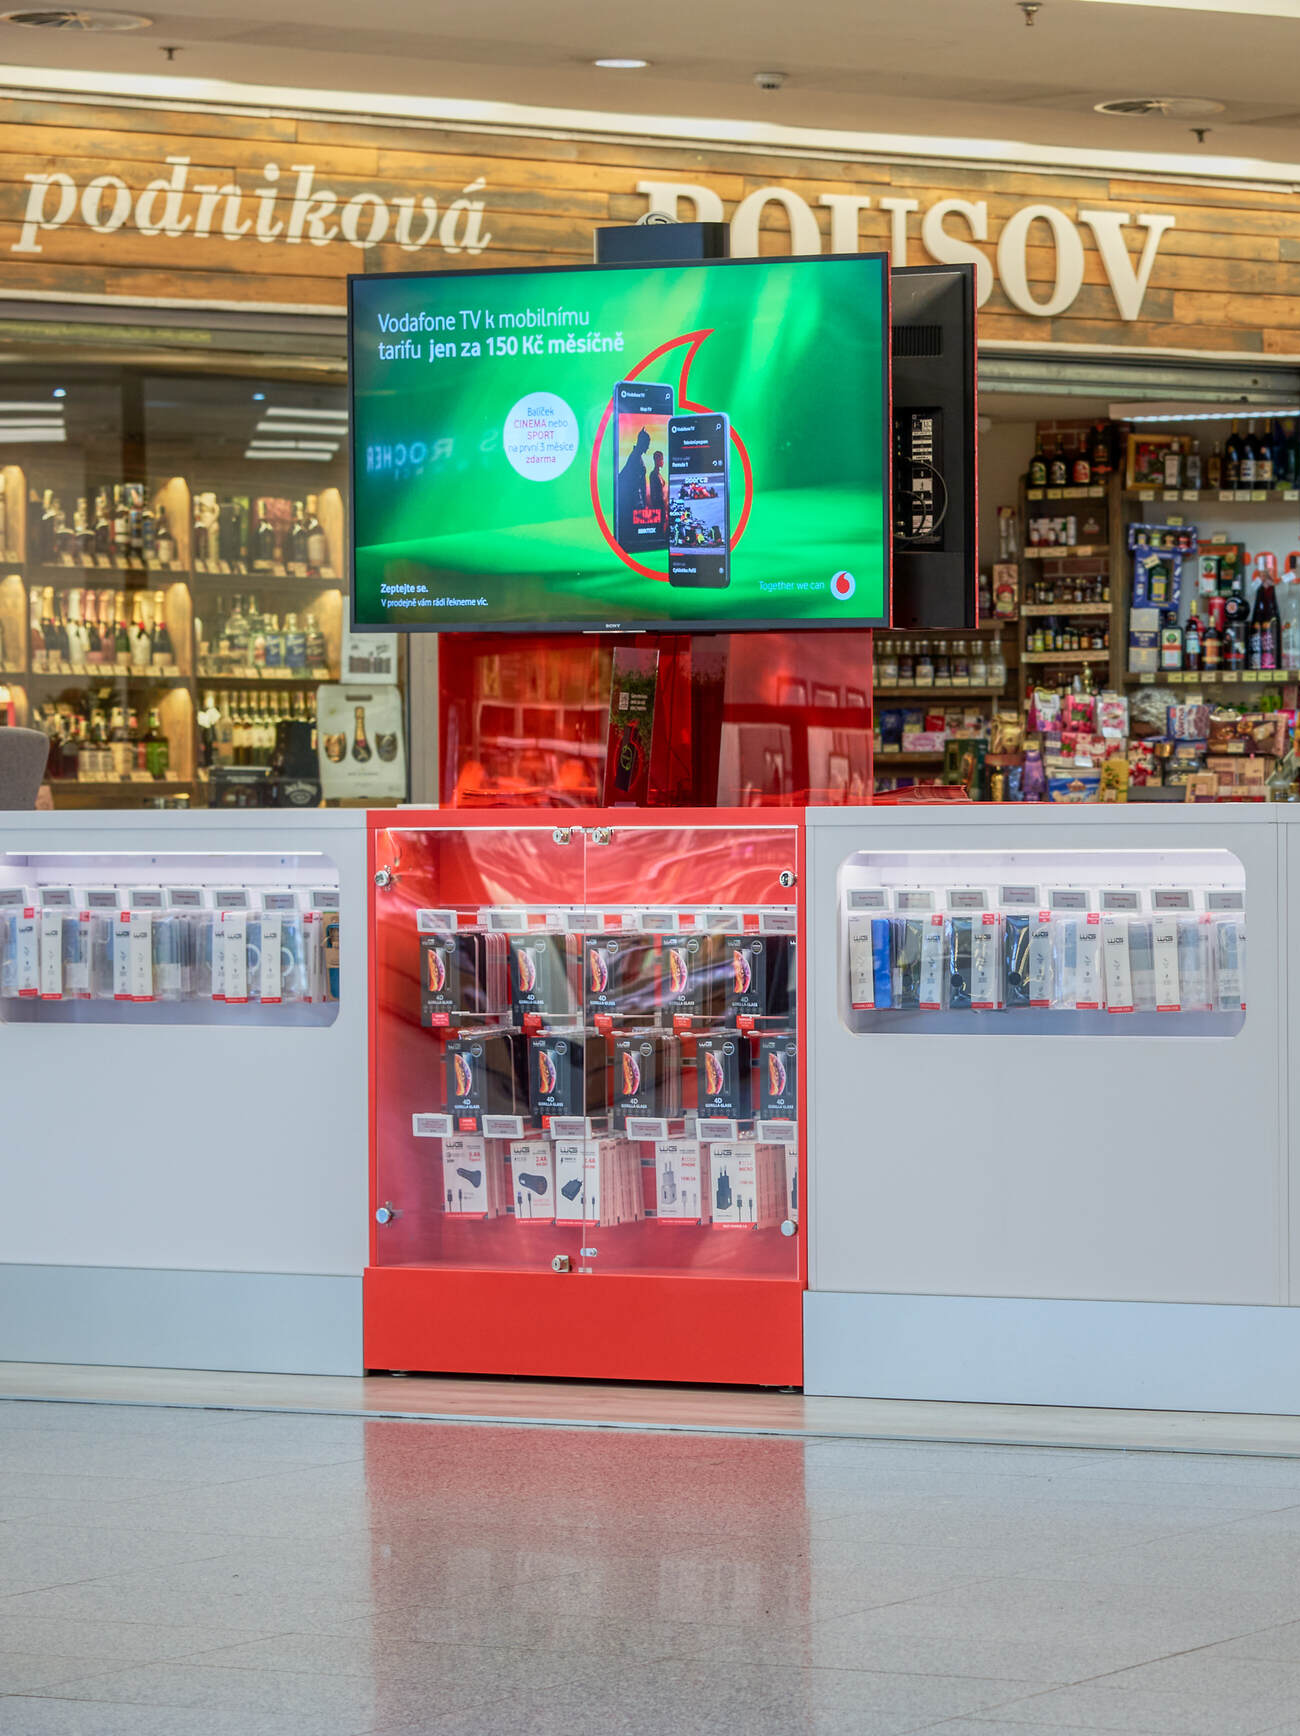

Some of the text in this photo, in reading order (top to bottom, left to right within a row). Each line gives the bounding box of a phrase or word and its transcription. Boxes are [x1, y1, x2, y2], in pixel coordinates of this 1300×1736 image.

[11, 155, 493, 256] podniková
[378, 306, 590, 333] Vodafone TV k mobilnímu
[378, 331, 625, 363] tarifu jen za 150 Kč měsíčně
[513, 419, 568, 429] CINEMA nebo
[527, 431, 555, 440] SPORT
[526, 455, 556, 464] zdarma
[380, 583, 429, 595] Zeptejte se.
[759, 580, 825, 593] Together we can
